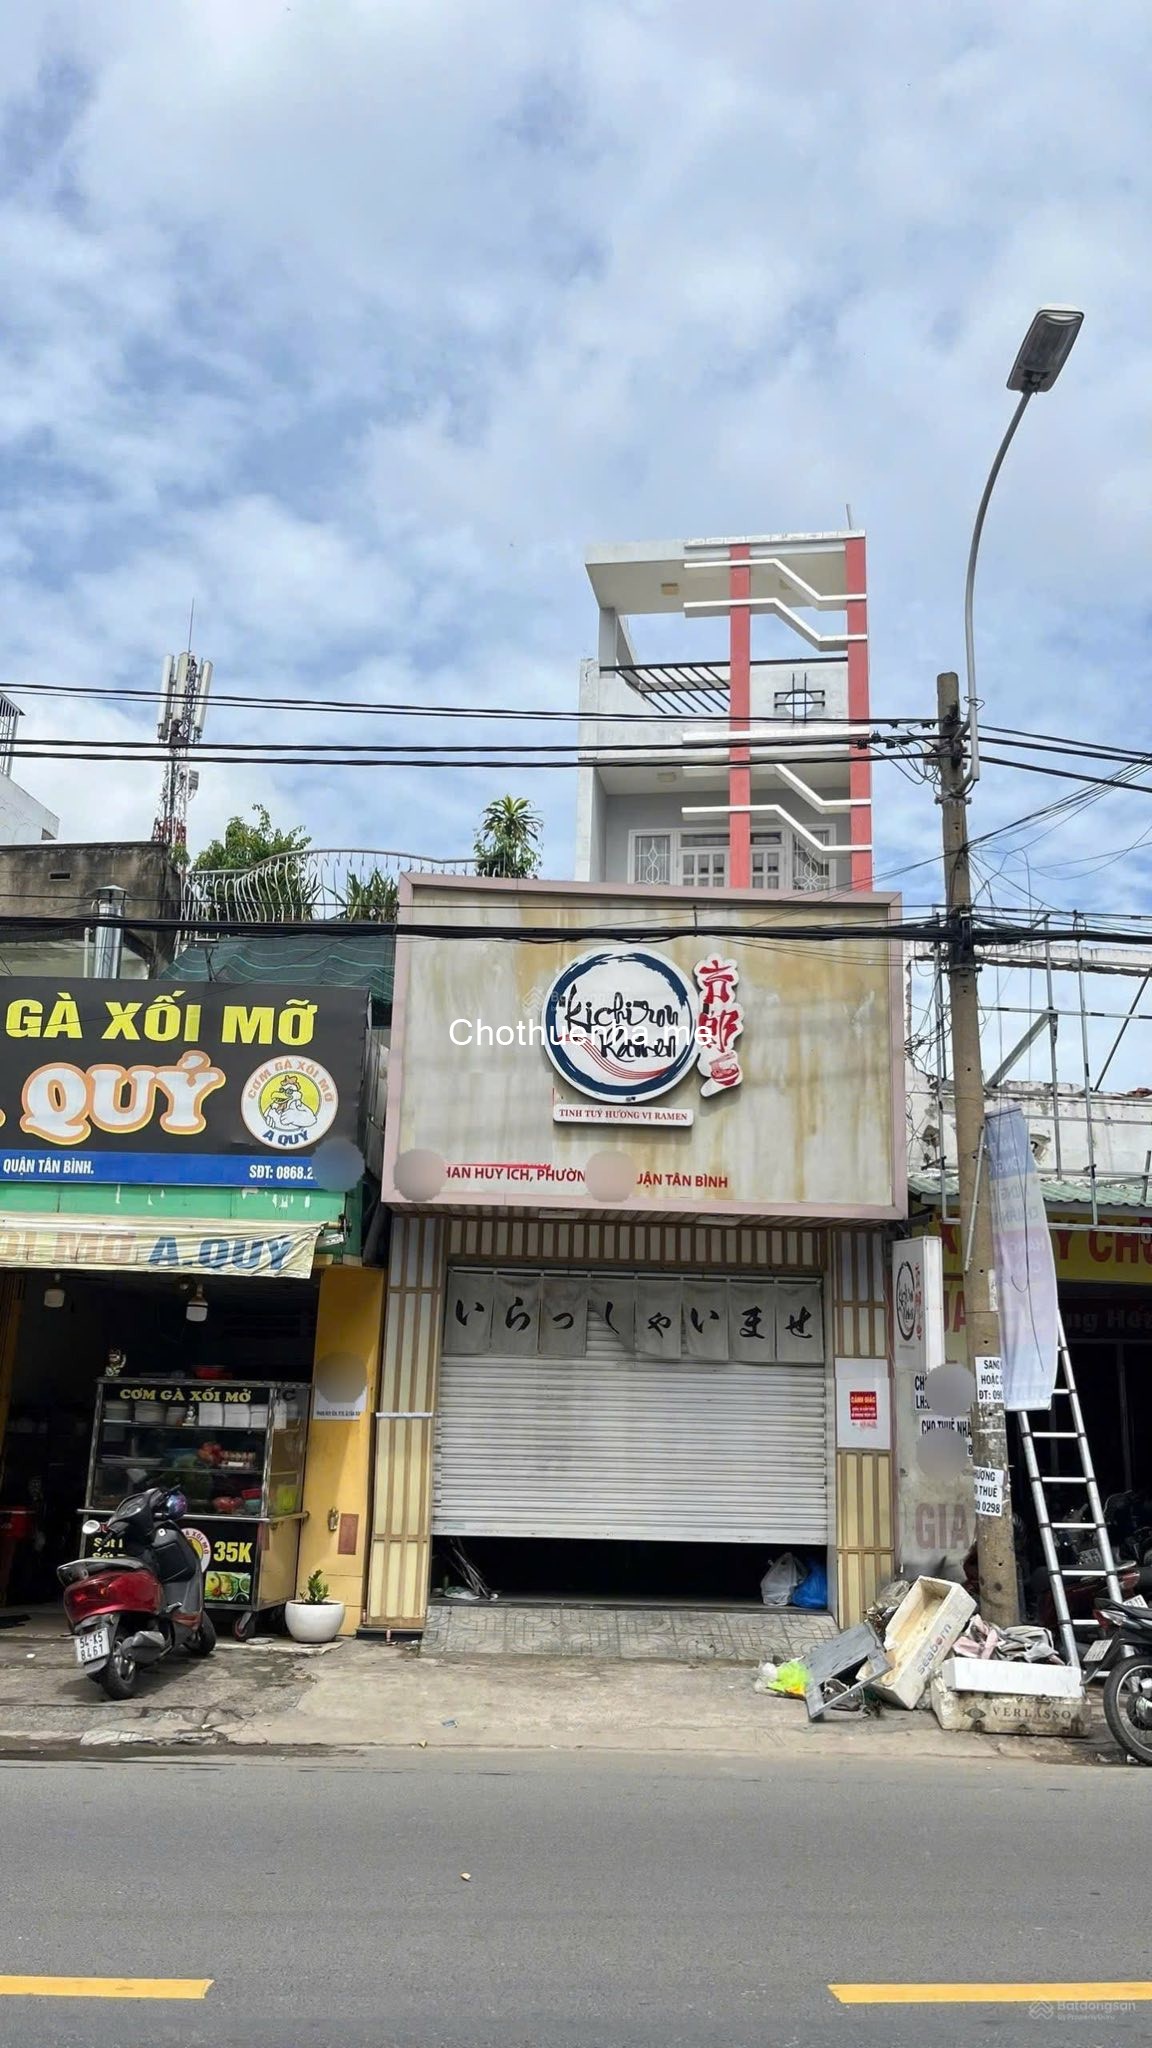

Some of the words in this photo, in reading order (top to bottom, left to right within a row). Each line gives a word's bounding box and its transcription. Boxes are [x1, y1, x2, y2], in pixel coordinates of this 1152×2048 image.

[5, 992, 83, 1040] GÀ
[102, 990, 202, 1042] XỐI
[221, 999, 318, 1046] MỠ
[20, 1050, 226, 1146] QUÝ
[655, 1111, 688, 1122] RAMEN
[262, 1129, 275, 1142] A
[3, 1156, 35, 1175] QUẬN
[38, 1156, 60, 1174] TÂN
[63, 1157, 94, 1175] BÌNH.
[249, 1164, 273, 1179] SĐT:
[276, 1165, 315, 1180] 0868.2
[475, 1167, 503, 1180] HUY
[636, 1170, 662, 1188] UẬN
[665, 1171, 692, 1187] TÂN
[695, 1172, 728, 1188] BÌNH
[120, 1387, 156, 1400] CƠM
[160, 1387, 185, 1401] GÀ
[189, 1386, 221, 1402] XỐI
[213, 1541, 253, 1564] 35K
[993, 1706, 1072, 1719] VERLASSO
